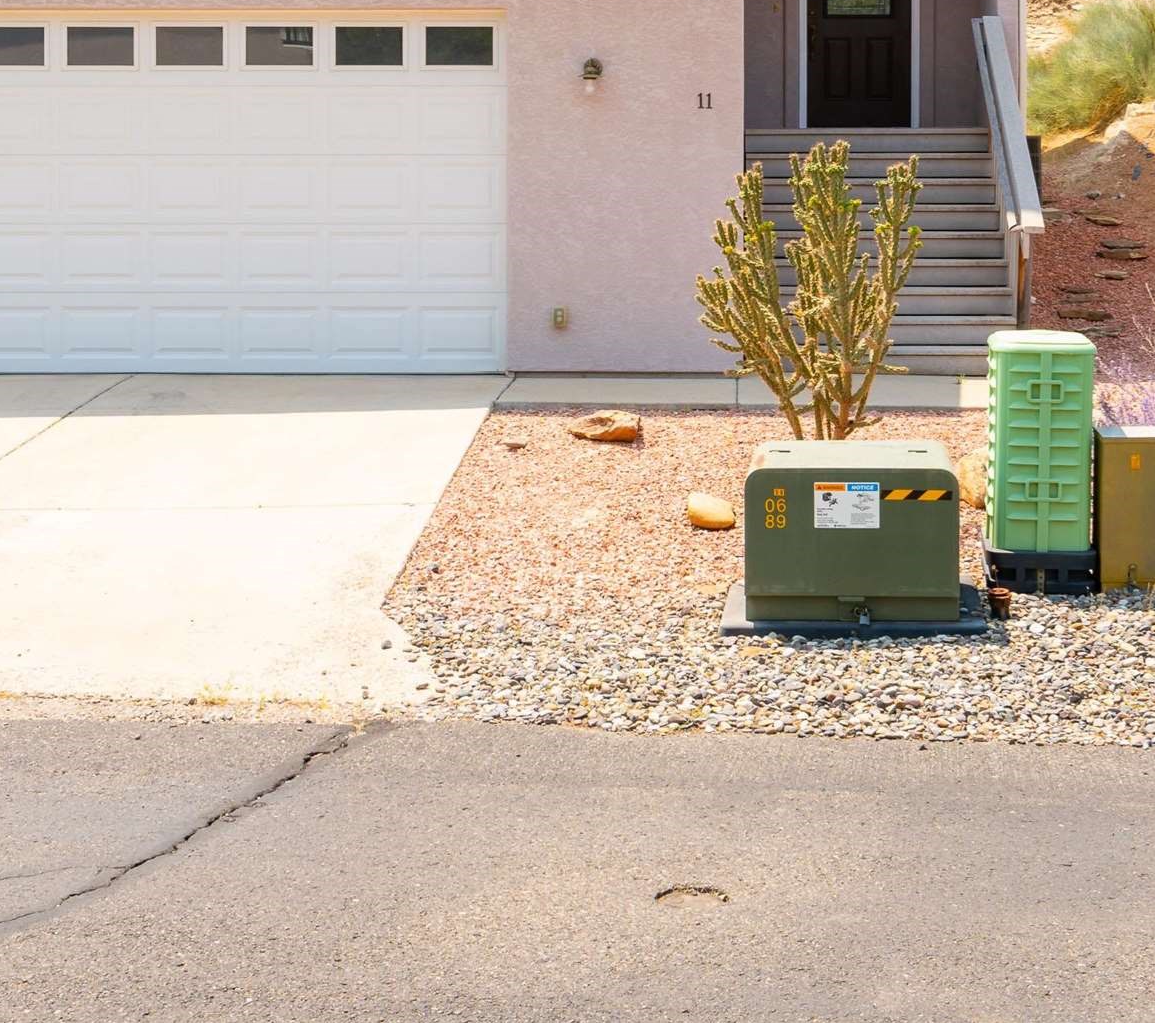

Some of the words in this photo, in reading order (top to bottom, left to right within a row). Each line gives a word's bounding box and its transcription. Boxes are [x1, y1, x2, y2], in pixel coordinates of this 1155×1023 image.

[697, 92, 713, 109] 11
[765, 498, 786, 513] 06
[765, 514, 786, 528] 89
